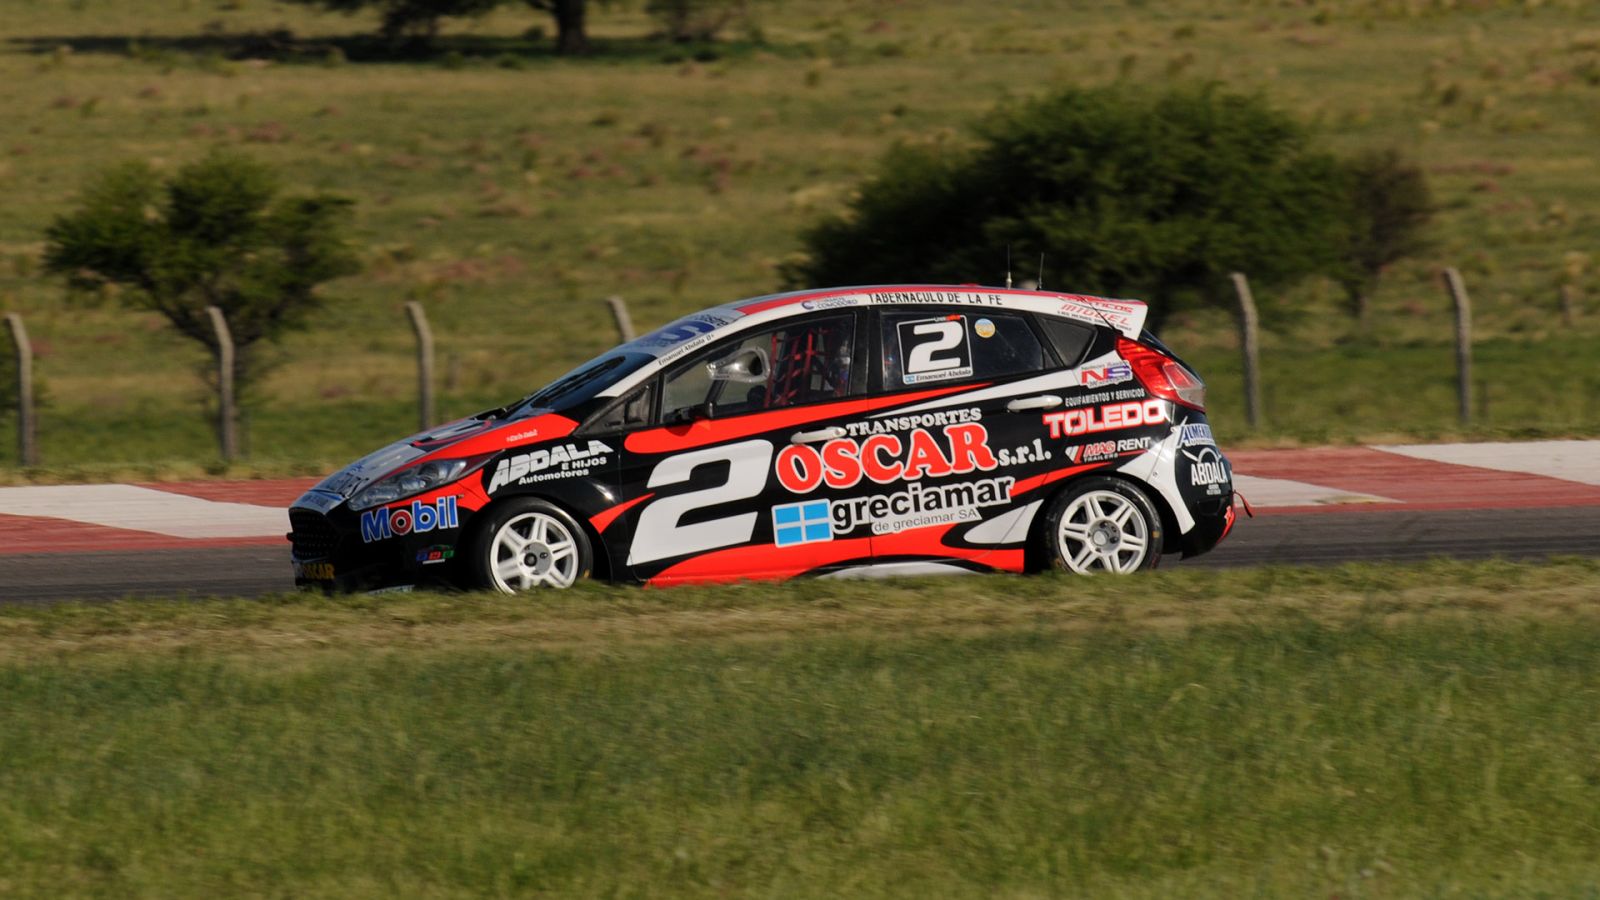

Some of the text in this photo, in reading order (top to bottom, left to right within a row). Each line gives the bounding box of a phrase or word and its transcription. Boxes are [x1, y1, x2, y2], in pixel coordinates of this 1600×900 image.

[867, 292, 1003, 306] TABERNACULO DE LA FE
[908, 321, 963, 373] 2
[1065, 387, 1145, 407] EQUIPAMIENTOS Y SERVICIOS
[846, 407, 982, 437] TRANSPORTES
[1042, 399, 1166, 439] TOLEDO
[776, 422, 1052, 494] OSCAR s.r.l.
[1084, 452, 1118, 462] TRAILERS
[1117, 437, 1151, 452] RENT
[487, 440, 614, 495] ABDALA
[518, 469, 590, 486] Automotores
[562, 456, 607, 471] E HIJOS
[1191, 461, 1229, 487] ABDALA
[626, 439, 774, 567] 2
[832, 477, 1015, 533] greciamar
[361, 495, 459, 543] Mobil
[874, 508, 979, 533] de greciamar SA
